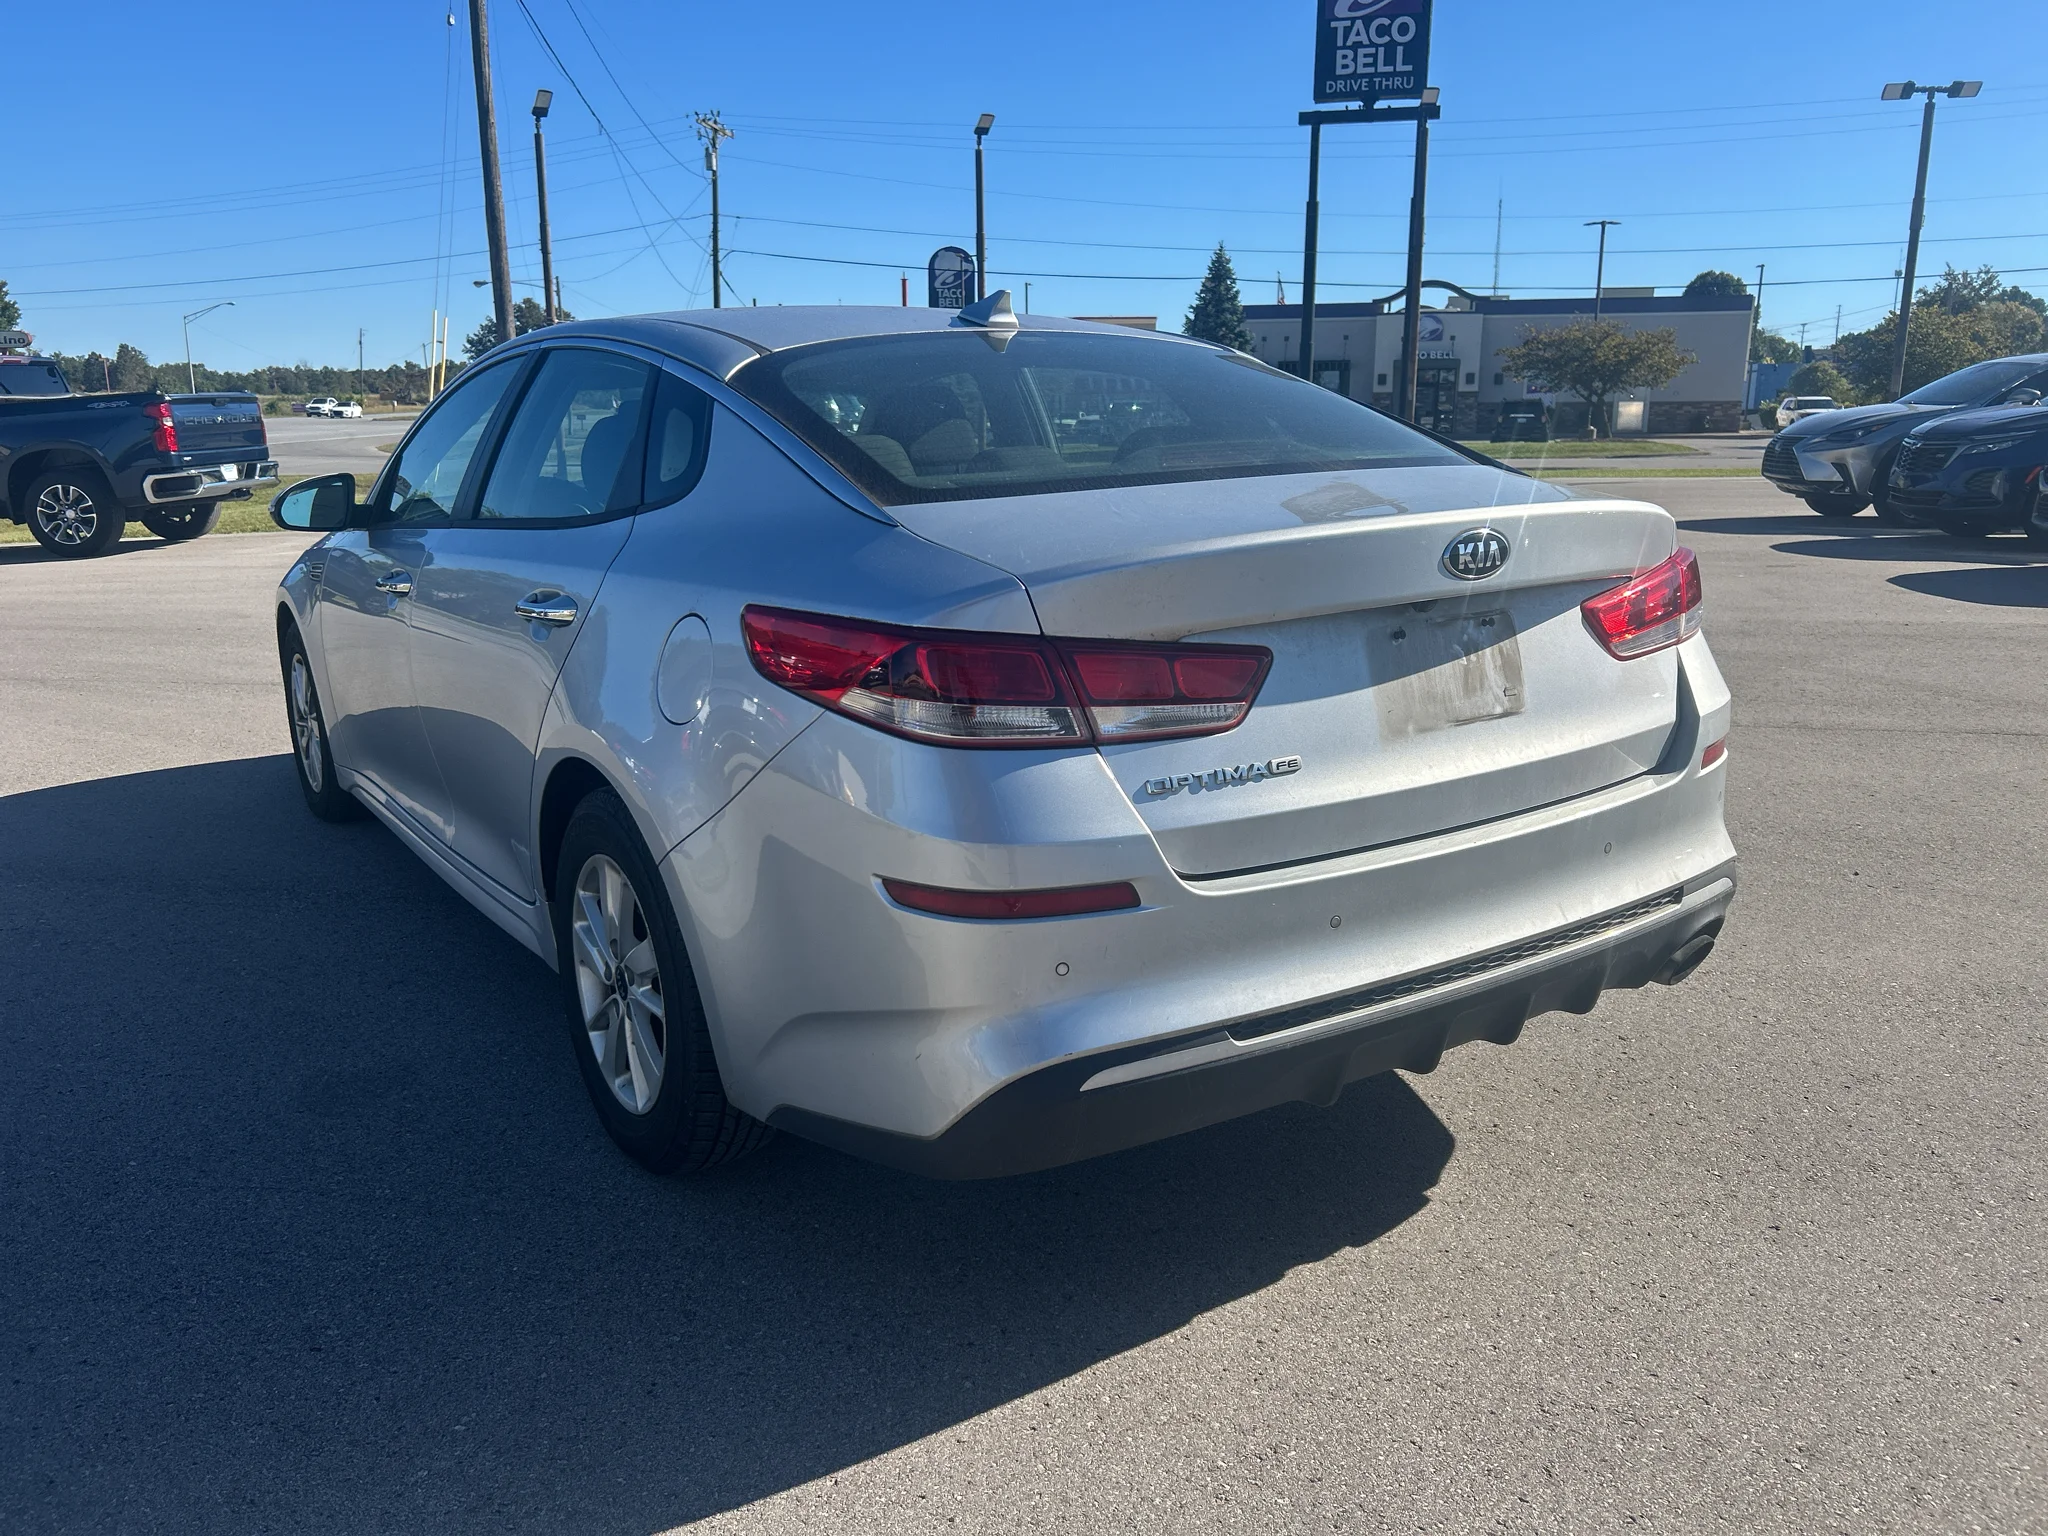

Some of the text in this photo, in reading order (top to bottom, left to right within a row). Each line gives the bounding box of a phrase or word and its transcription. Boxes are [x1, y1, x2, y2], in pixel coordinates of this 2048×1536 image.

[1330, 16, 1416, 47] TACO
[1335, 46, 1413, 75] BELL
[1326, 76, 1414, 93] DRIVE THRU
[1430, 351, 1454, 359] BELL
[183, 414, 260, 425] CHEVROLET
[1457, 540, 1501, 570] KIA
[1147, 759, 1299, 795] OPTIMA FE
